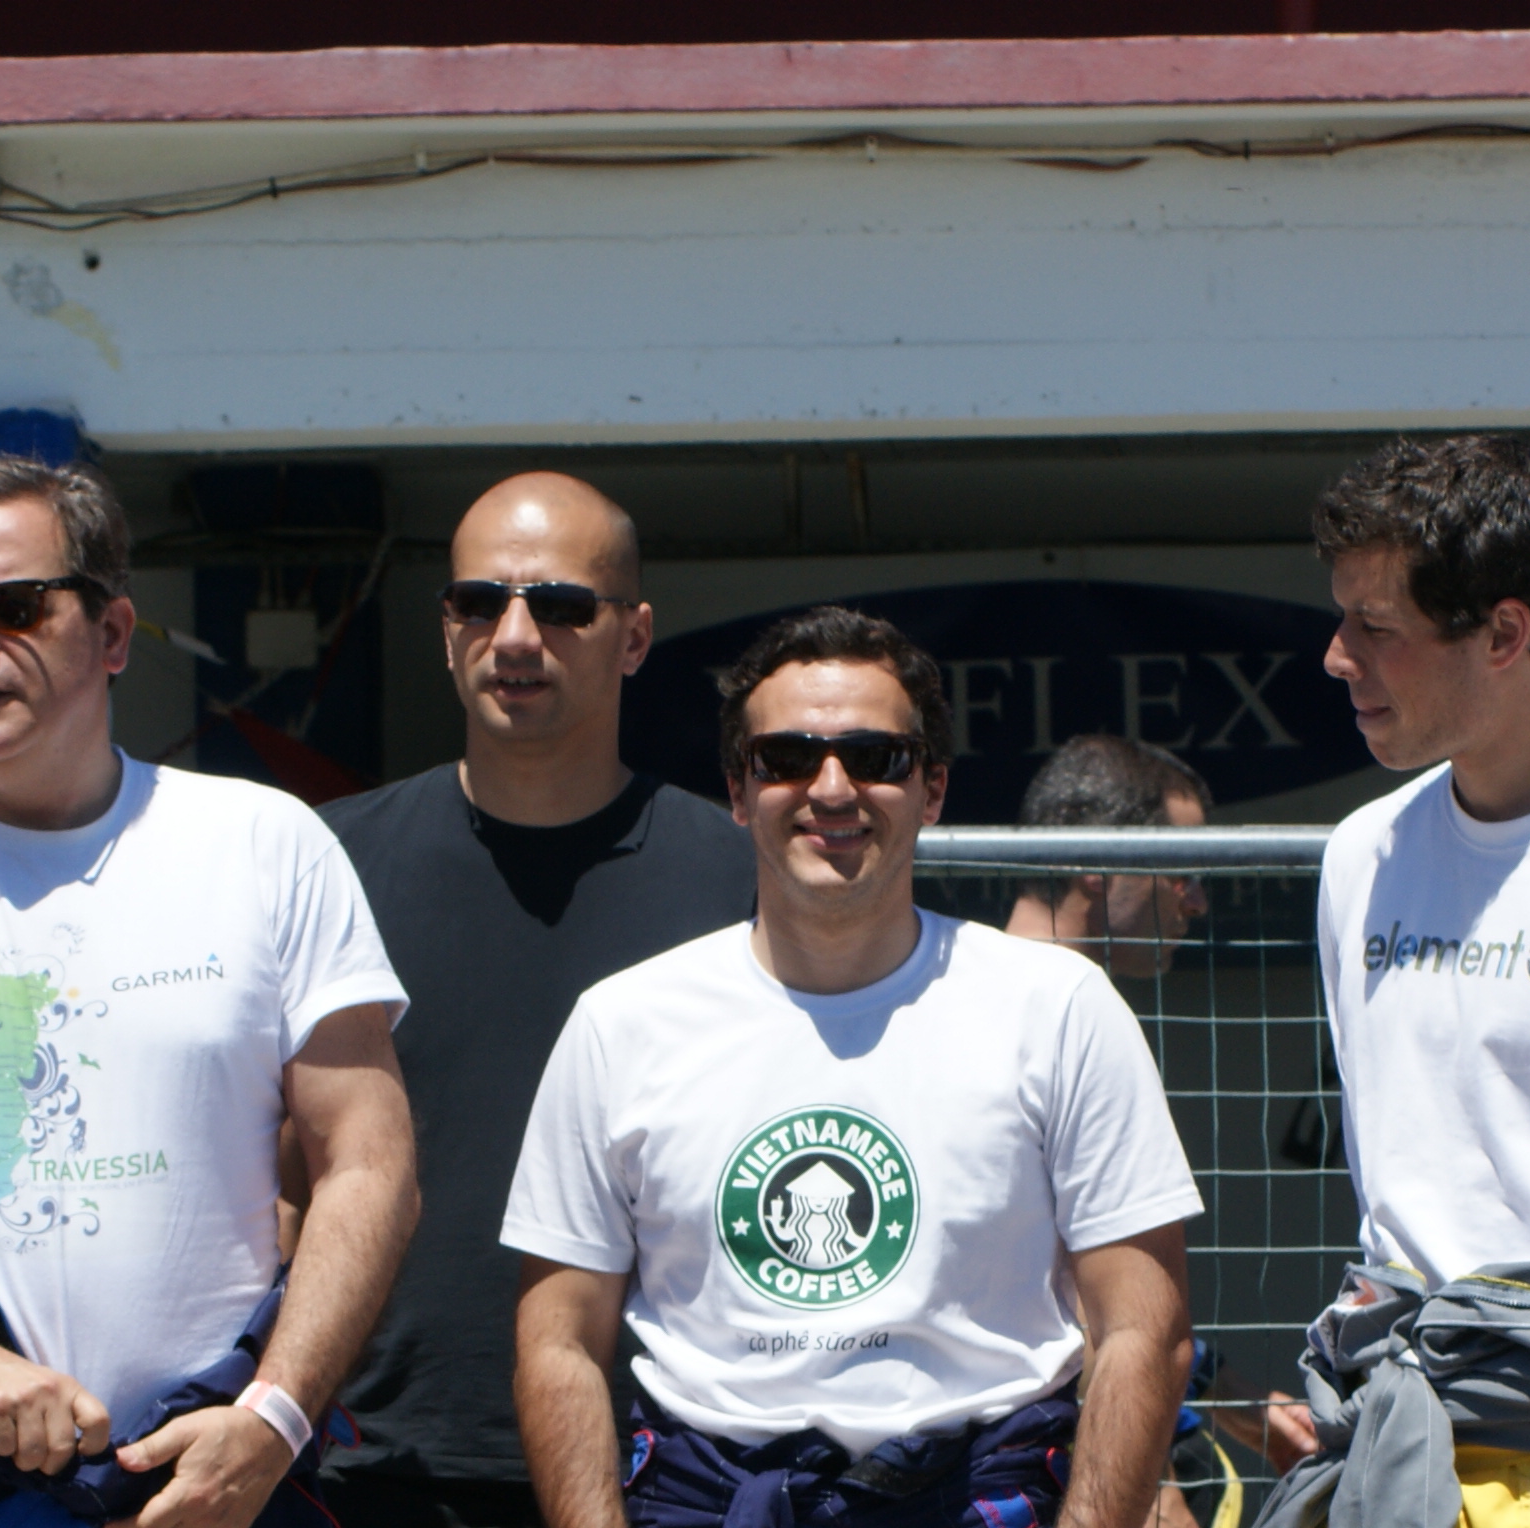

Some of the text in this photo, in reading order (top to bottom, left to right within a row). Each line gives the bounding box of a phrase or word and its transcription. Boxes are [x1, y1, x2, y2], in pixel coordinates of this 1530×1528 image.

[1363, 920, 1525, 980] element
[112, 964, 225, 993] GARMIN
[29, 1151, 169, 1182] TRAVESSIA
[732, 1118, 907, 1202] VIETNAMESE
[758, 1258, 879, 1300] COFFEE
